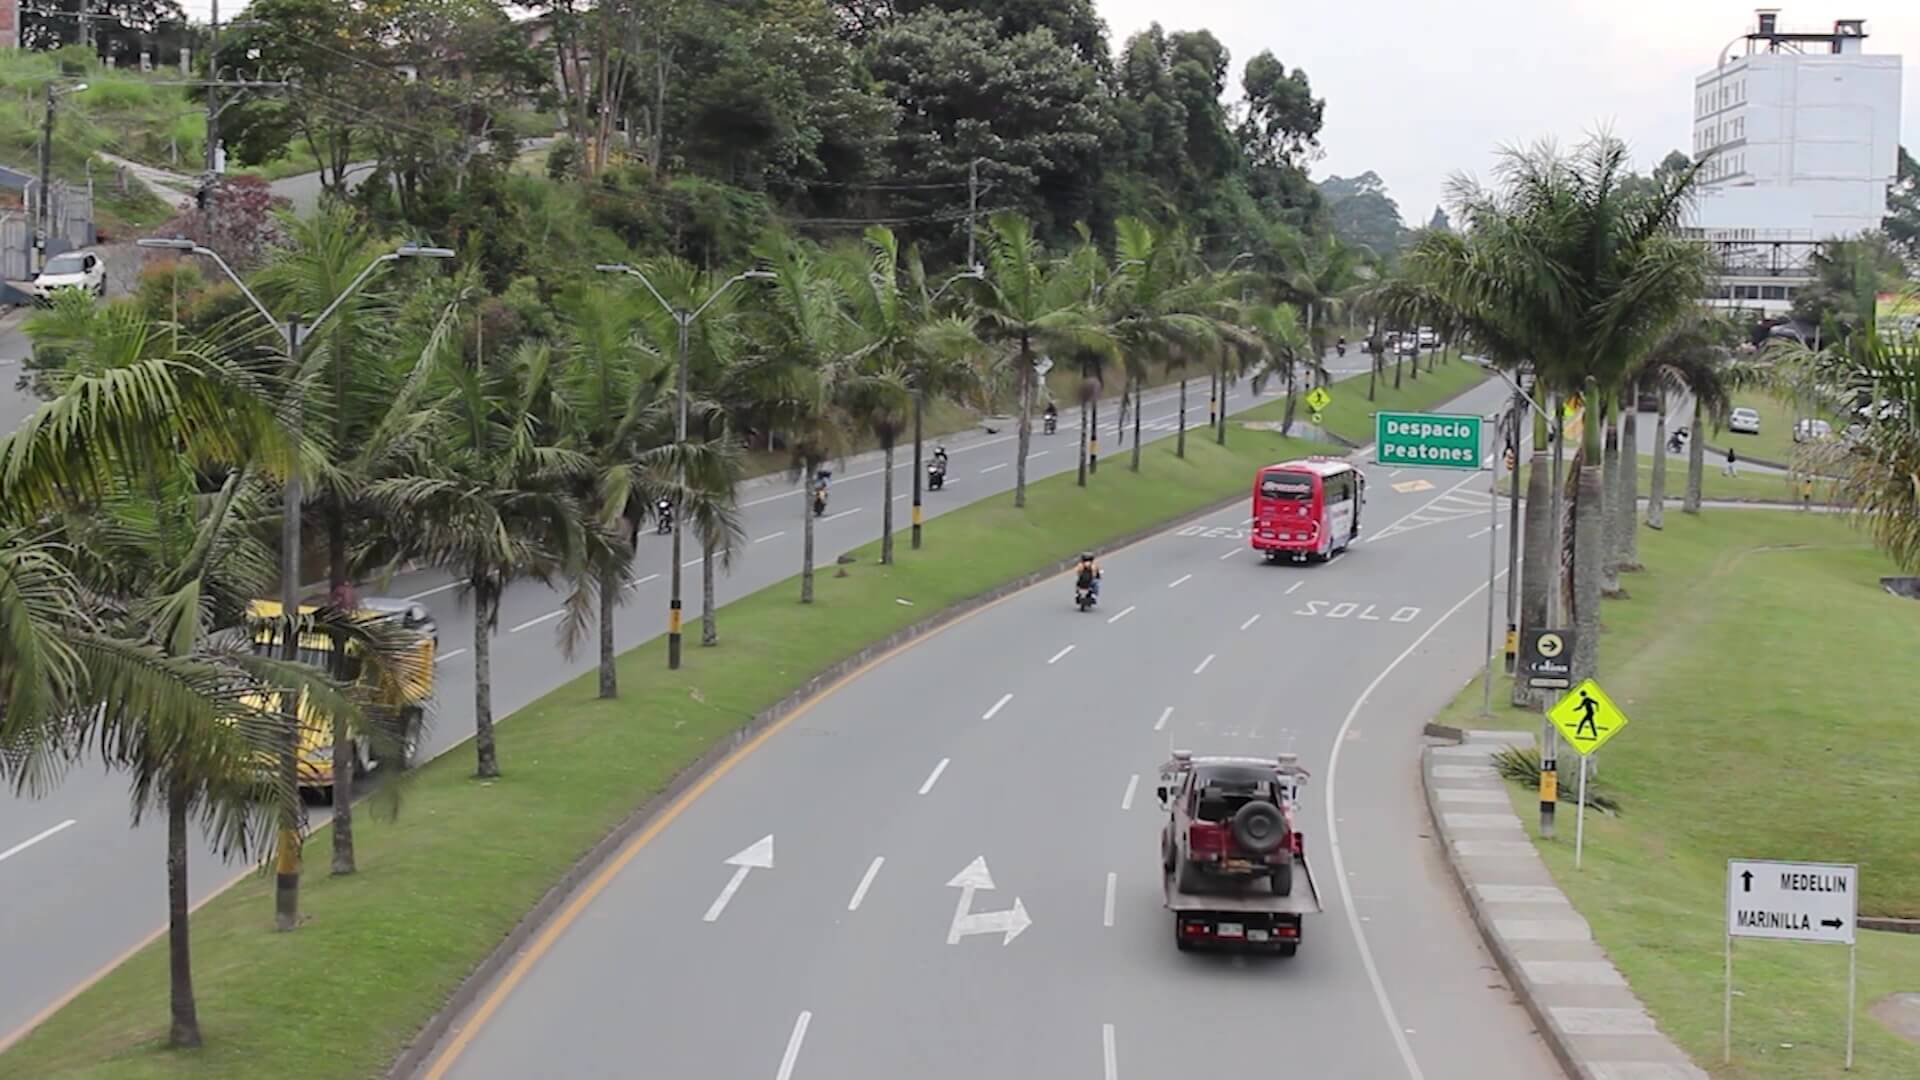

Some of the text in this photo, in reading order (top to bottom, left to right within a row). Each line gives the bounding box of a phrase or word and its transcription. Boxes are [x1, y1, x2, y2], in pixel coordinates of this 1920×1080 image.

[1387, 421, 1470, 438] Despacio
[1384, 444, 1473, 461] Peatones
[1293, 600, 1421, 622] SOLO
[1780, 873, 1847, 892] MEDELLIN
[1737, 909, 1811, 930] MARINILLA
